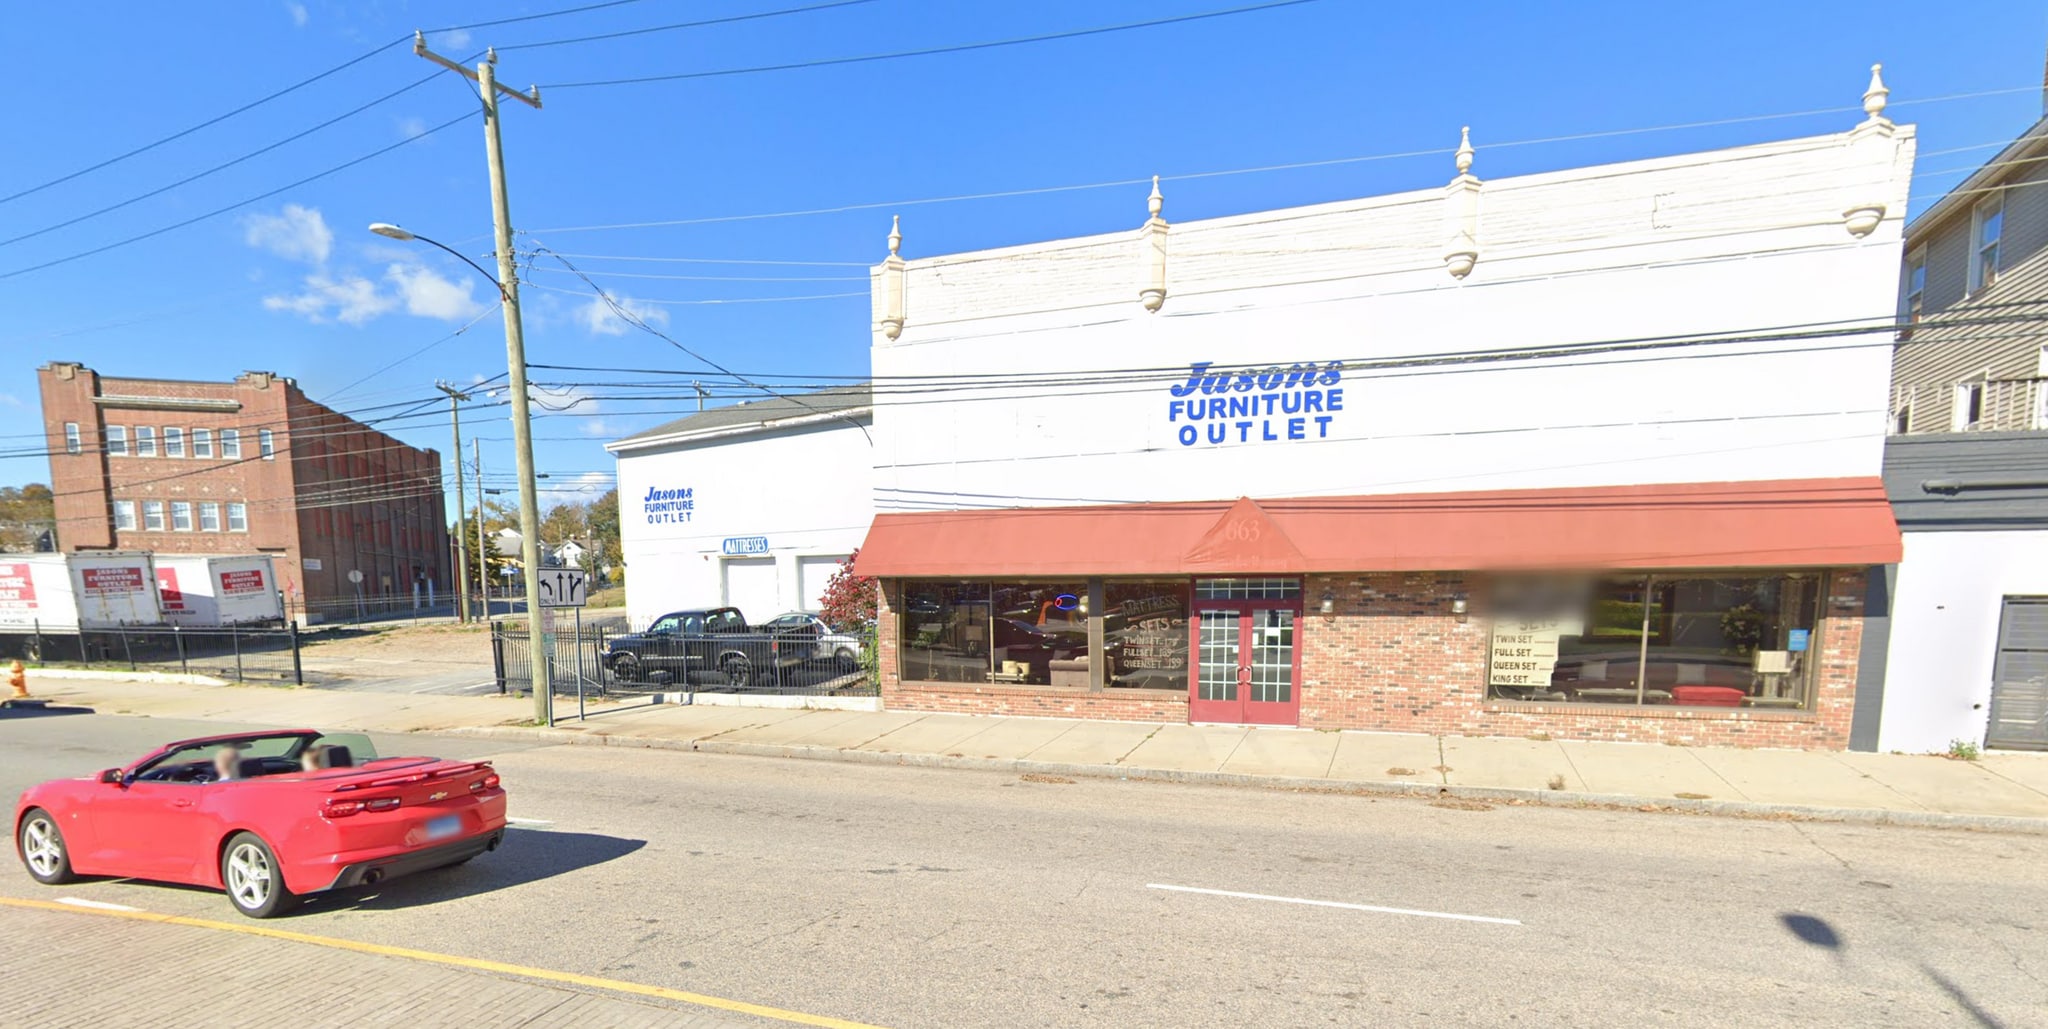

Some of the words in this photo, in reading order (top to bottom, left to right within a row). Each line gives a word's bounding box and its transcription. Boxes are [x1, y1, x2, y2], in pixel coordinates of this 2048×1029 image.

[1170, 360, 1344, 397] Jasons
[1169, 388, 1343, 422] FURNITURE
[1178, 416, 1333, 446] OUTLET
[644, 486, 693, 502] Jasons
[644, 500, 694, 513] FURNITURE
[647, 512, 692, 524] OUTLET
[725, 537, 766, 553] MATTRESSES
[87, 574, 138, 582] FURNITURE
[1120, 594, 1179, 616] MATTRESS
[1139, 618, 1170, 633] SETS
[1495, 634, 1516, 644] TWIN
[1517, 634, 1533, 644] SET
[1494, 648, 1514, 657] FULL
[1516, 648, 1532, 657] SET
[1493, 661, 1520, 670] QUEEN
[1521, 662, 1537, 670] SET
[1492, 675, 1511, 684] KING
[1513, 675, 1528, 684] SET
